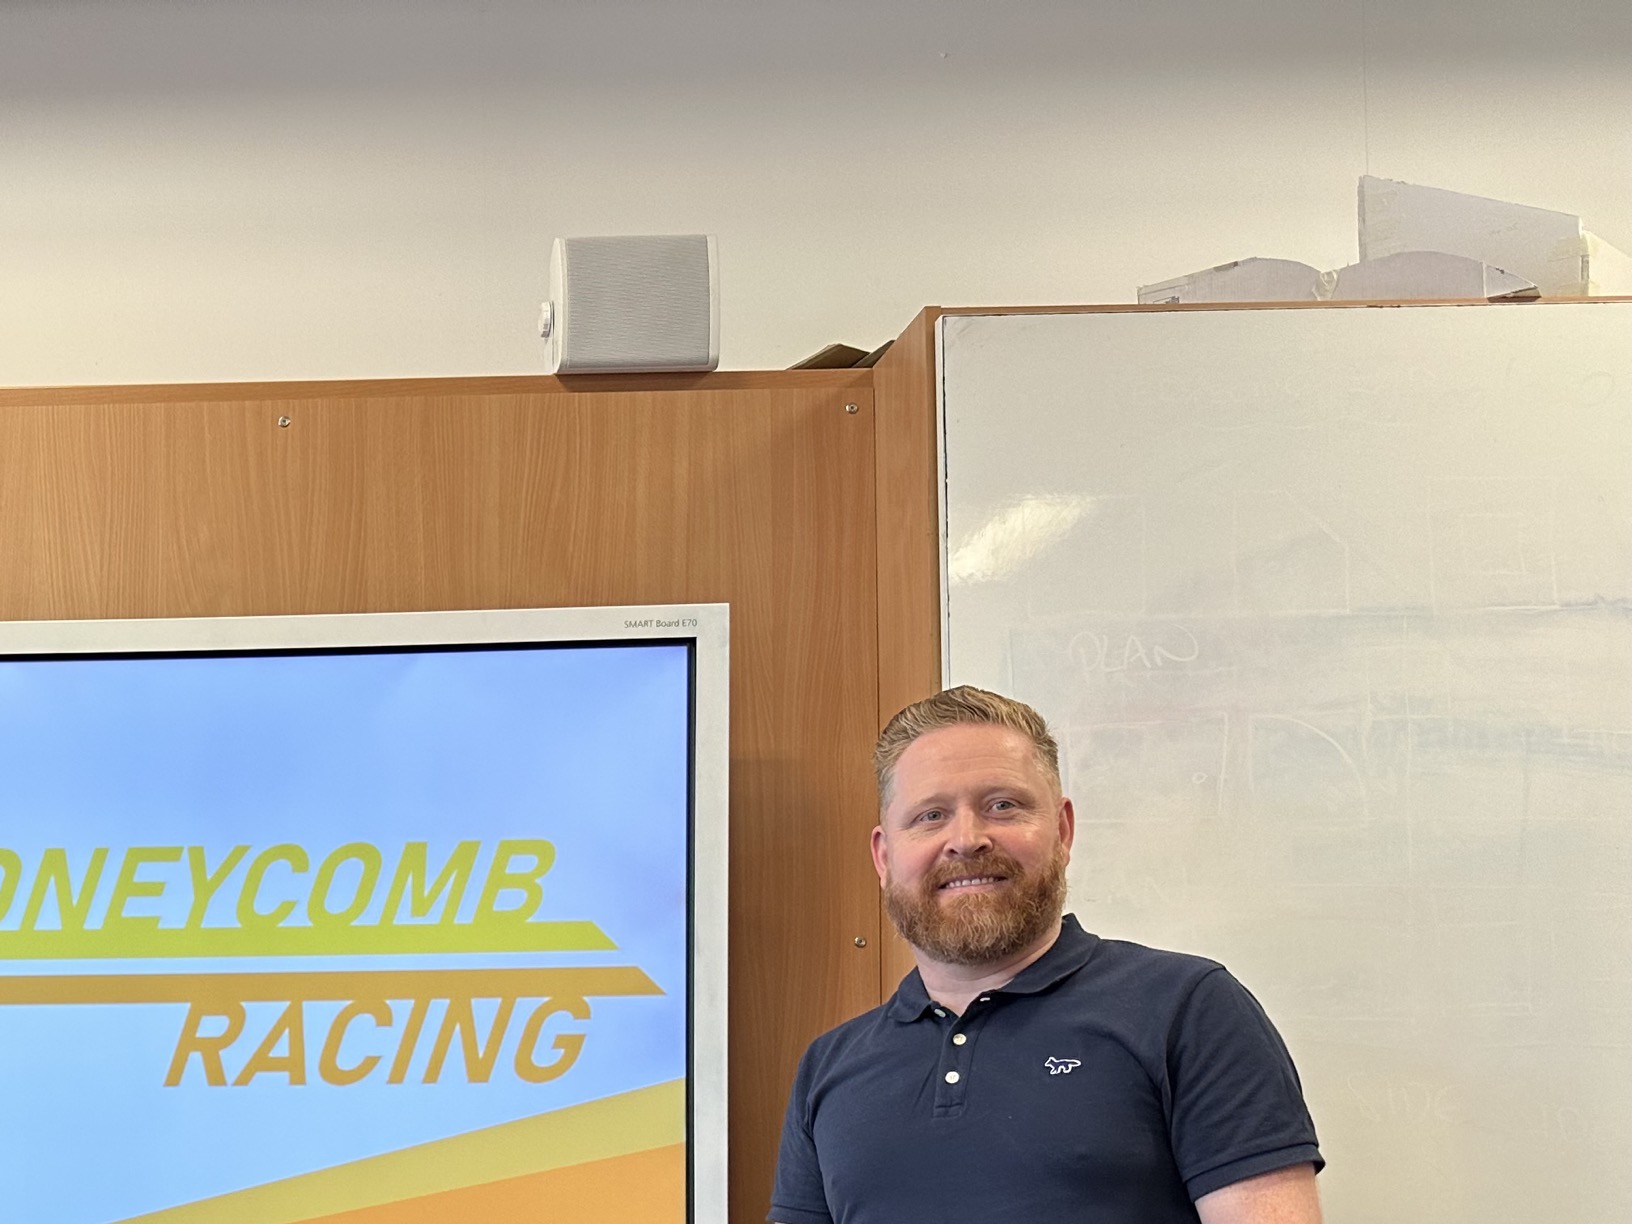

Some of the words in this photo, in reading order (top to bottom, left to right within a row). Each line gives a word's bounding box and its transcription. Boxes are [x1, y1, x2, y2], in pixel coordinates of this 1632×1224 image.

[624, 620, 654, 628] SMART
[655, 619, 680, 628] Board
[682, 618, 698, 627] E70
[164, 995, 591, 1087] RACING
